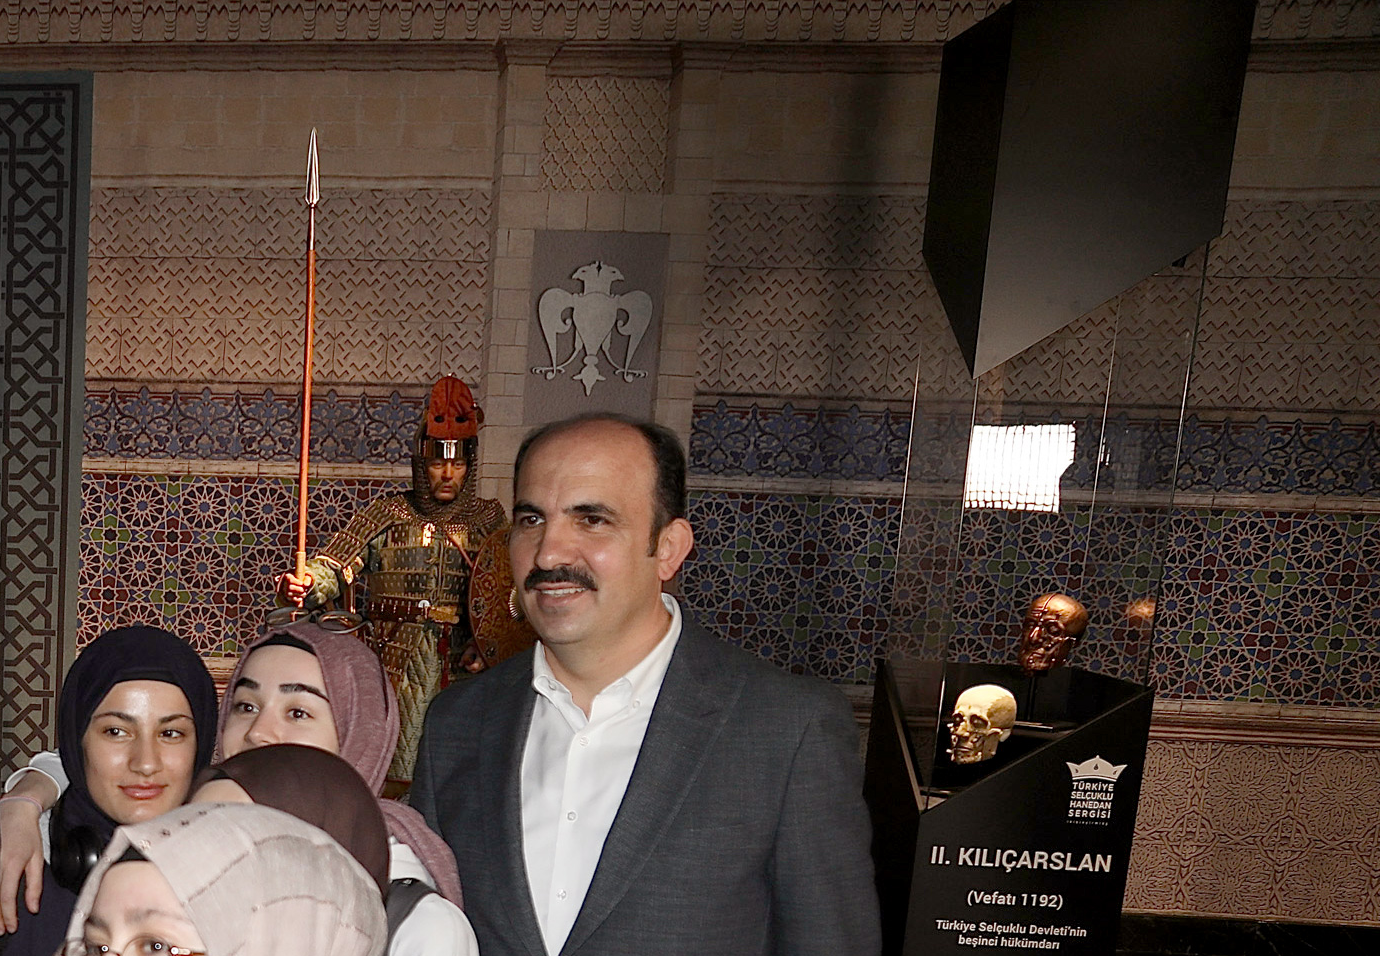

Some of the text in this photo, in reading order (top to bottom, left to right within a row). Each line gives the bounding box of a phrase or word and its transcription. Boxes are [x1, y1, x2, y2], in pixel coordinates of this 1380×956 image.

[1072, 781, 1115, 792] TÜRKİYE
[1070, 791, 1114, 801] SELÇUKLU
[1069, 800, 1112, 810] HANEDAN
[1067, 809, 1111, 819] SERGİSİ
[930, 846, 1112, 873] II. KILIÇARSLAN
[967, 890, 1063, 910] (Vefatı 1192)
[935, 919, 1087, 937] Türkiye Selçuklu Devleti'nin
[958, 934, 1060, 950] beşinci hükümdarı
